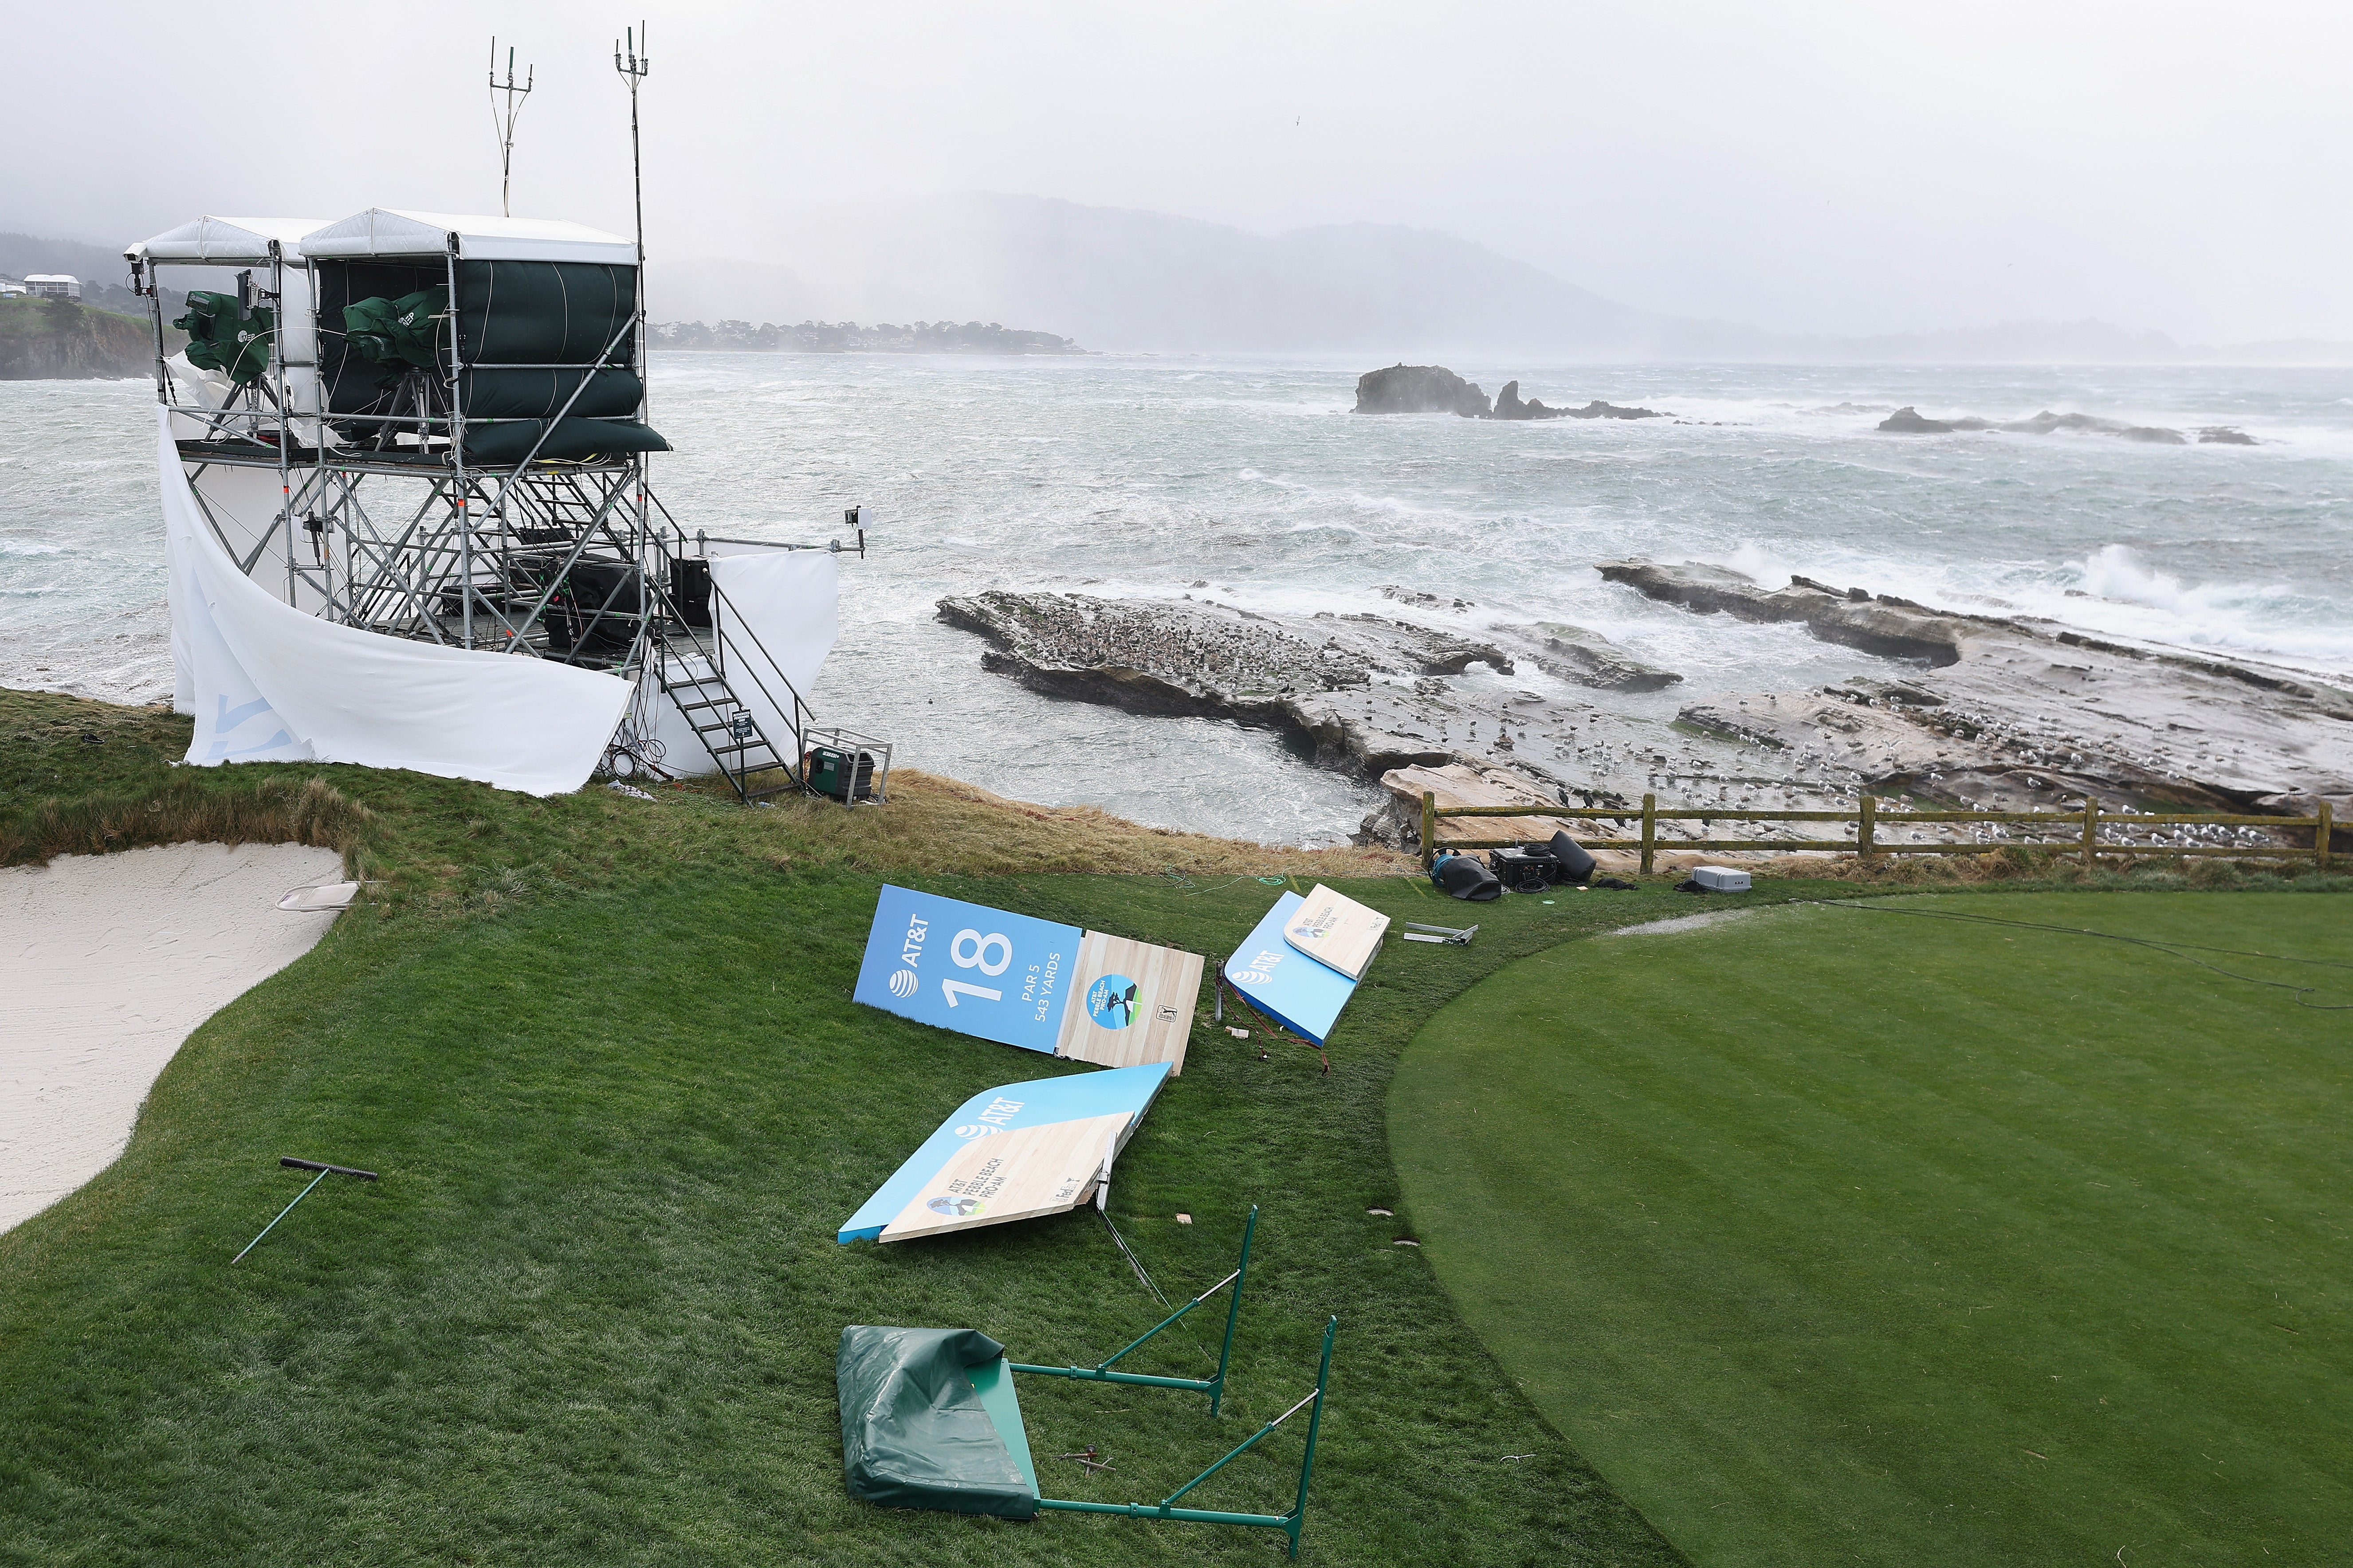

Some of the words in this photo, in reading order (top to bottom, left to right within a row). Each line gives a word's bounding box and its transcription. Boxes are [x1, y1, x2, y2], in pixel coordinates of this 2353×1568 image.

[403, 312, 414, 327] NEP
[243, 333, 255, 342] NEP
[901, 913, 928, 968] AT&T
[942, 929, 1013, 1008] 18
[1029, 964, 1040, 973] 5
[1248, 950, 1285, 972] AT&T
[1040, 952, 1061, 996] YARDS
[1021, 975, 1038, 1002] PAR
[1097, 980, 1106, 998] BEACH
[1034, 999, 1049, 1022] 543
[1093, 996, 1102, 1017] PEBBLE
[1100, 989, 1109, 1011] PRO-AM
[977, 1097, 1025, 1126] AT&T
[947, 1179, 968, 1194] AT&T
[962, 1176, 989, 1196] PEBBLE
[978, 1158, 1004, 1176] BEACH
[978, 1176, 1007, 1198] PRO-AM
